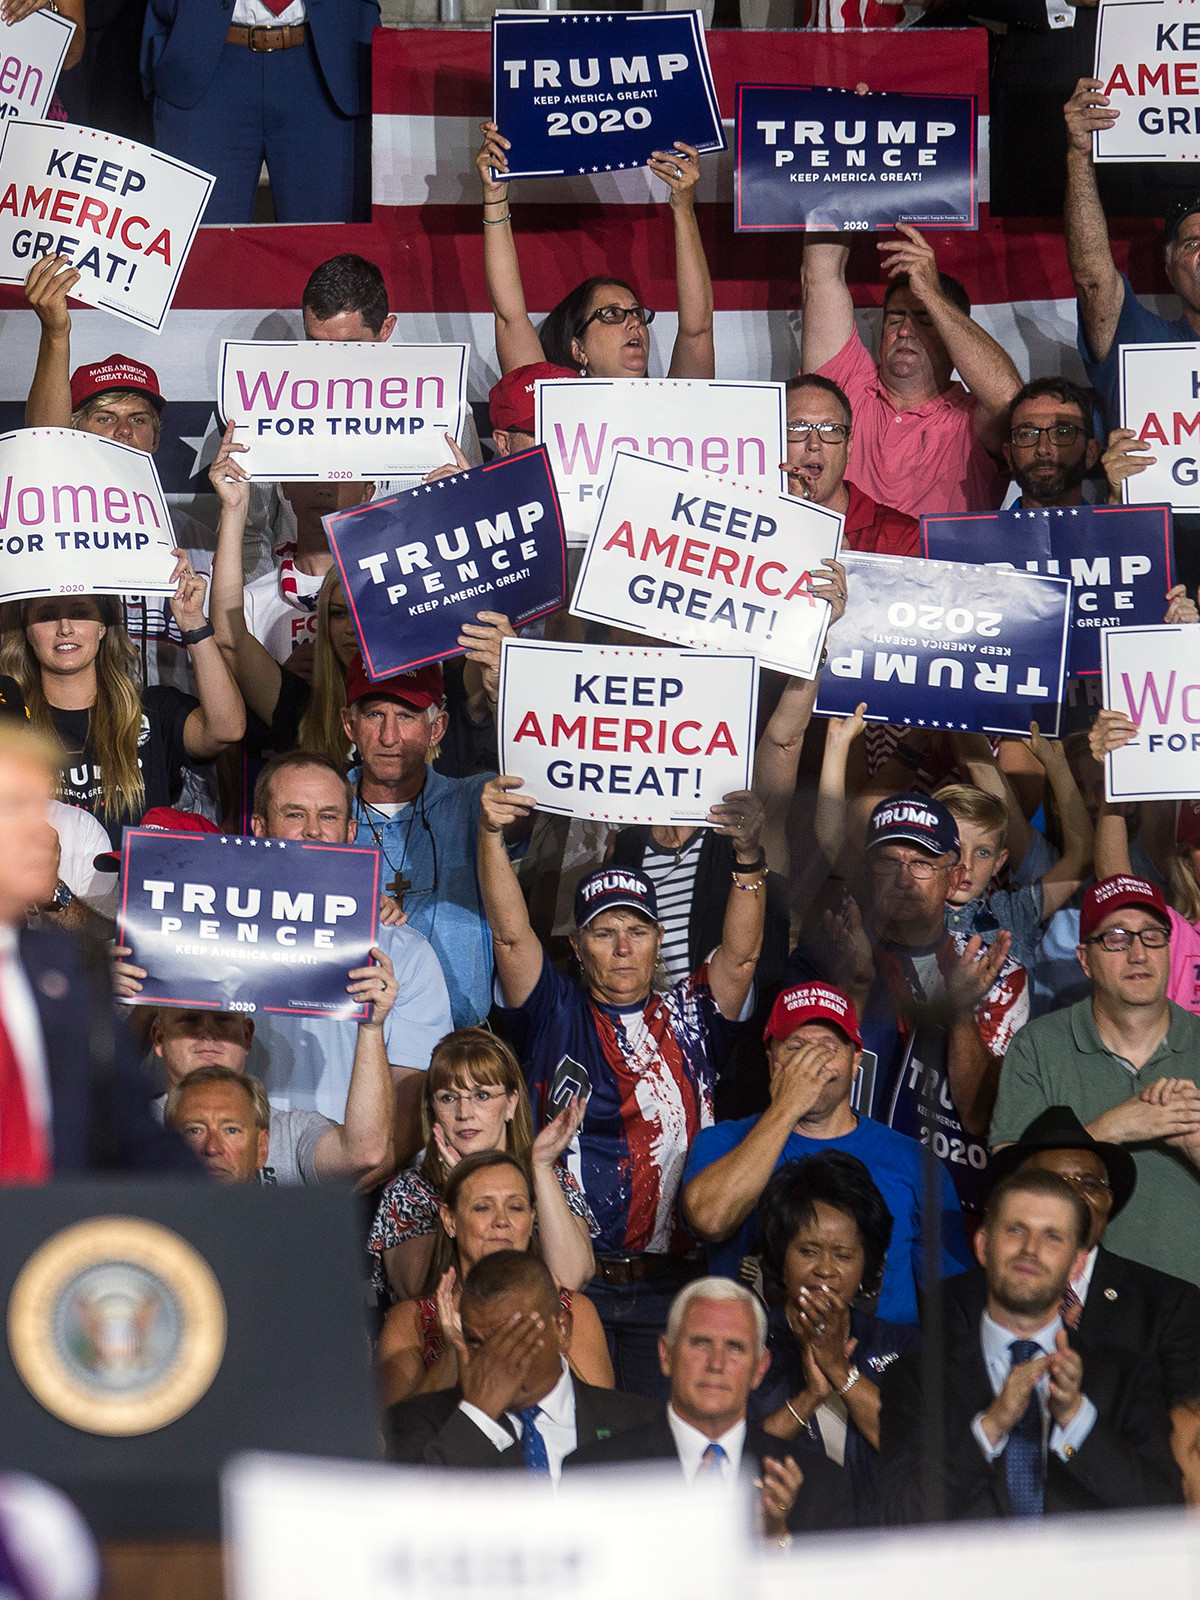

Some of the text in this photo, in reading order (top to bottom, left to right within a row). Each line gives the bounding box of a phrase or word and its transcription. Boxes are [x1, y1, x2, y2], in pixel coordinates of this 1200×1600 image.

[503, 53, 689, 89] TRUMP
[534, 89, 658, 105] KEEP AMERICA GREAT!
[547, 106, 652, 137] 2020
[756, 120, 956, 145] TRUMP
[46, 149, 147, 197] KEEP
[775, 149, 937, 167] PENCE
[790, 172, 922, 182] KEEP AMERICA GREAT!
[843, 221, 869, 230] 2020
[12, 230, 138, 293] GREAT!
[89, 364, 148, 378] MAKE AMERICA
[94, 372, 146, 384] GREAT AGAIN
[236, 370, 445, 411] Women
[257, 417, 425, 436] FOR TRUMP
[554, 422, 766, 476] Wmen
[327, 471, 353, 479] 2020
[671, 492, 778, 544] KEEP
[55, 531, 150, 550] TRUMP
[358, 500, 545, 585] TRUMP
[387, 539, 538, 605] PENCE
[603, 520, 817, 609] AMERICA
[59, 584, 85, 593] 2020
[408, 568, 530, 617] KEEP AMERICA GREAT!
[628, 574, 778, 641] GREAT!
[886, 601, 1004, 637] 2020
[1077, 617, 1121, 628] GREAT!
[872, 634, 1012, 656] KEEP AMERICA GREAT!
[830, 649, 1049, 698] TRUMP
[574, 673, 684, 707] KEEP
[513, 711, 738, 757] AMERICA
[546, 760, 702, 799] GREAT!
[873, 809, 939, 830] TRUMP
[143, 879, 357, 925] TRUMP
[581, 875, 648, 902] TRUMP
[1096, 888, 1125, 904] GREAT
[161, 917, 335, 949] PENCE
[175, 944, 317, 965] KEEP AMERICA GREAT!
[228, 1001, 256, 1013] 2020
[783, 988, 848, 1008] MAKE AMERICA
[786, 997, 846, 1017] GREAT AGAIN
[908, 1057, 953, 1110] TRU
[920, 1126, 988, 1170] 2020
